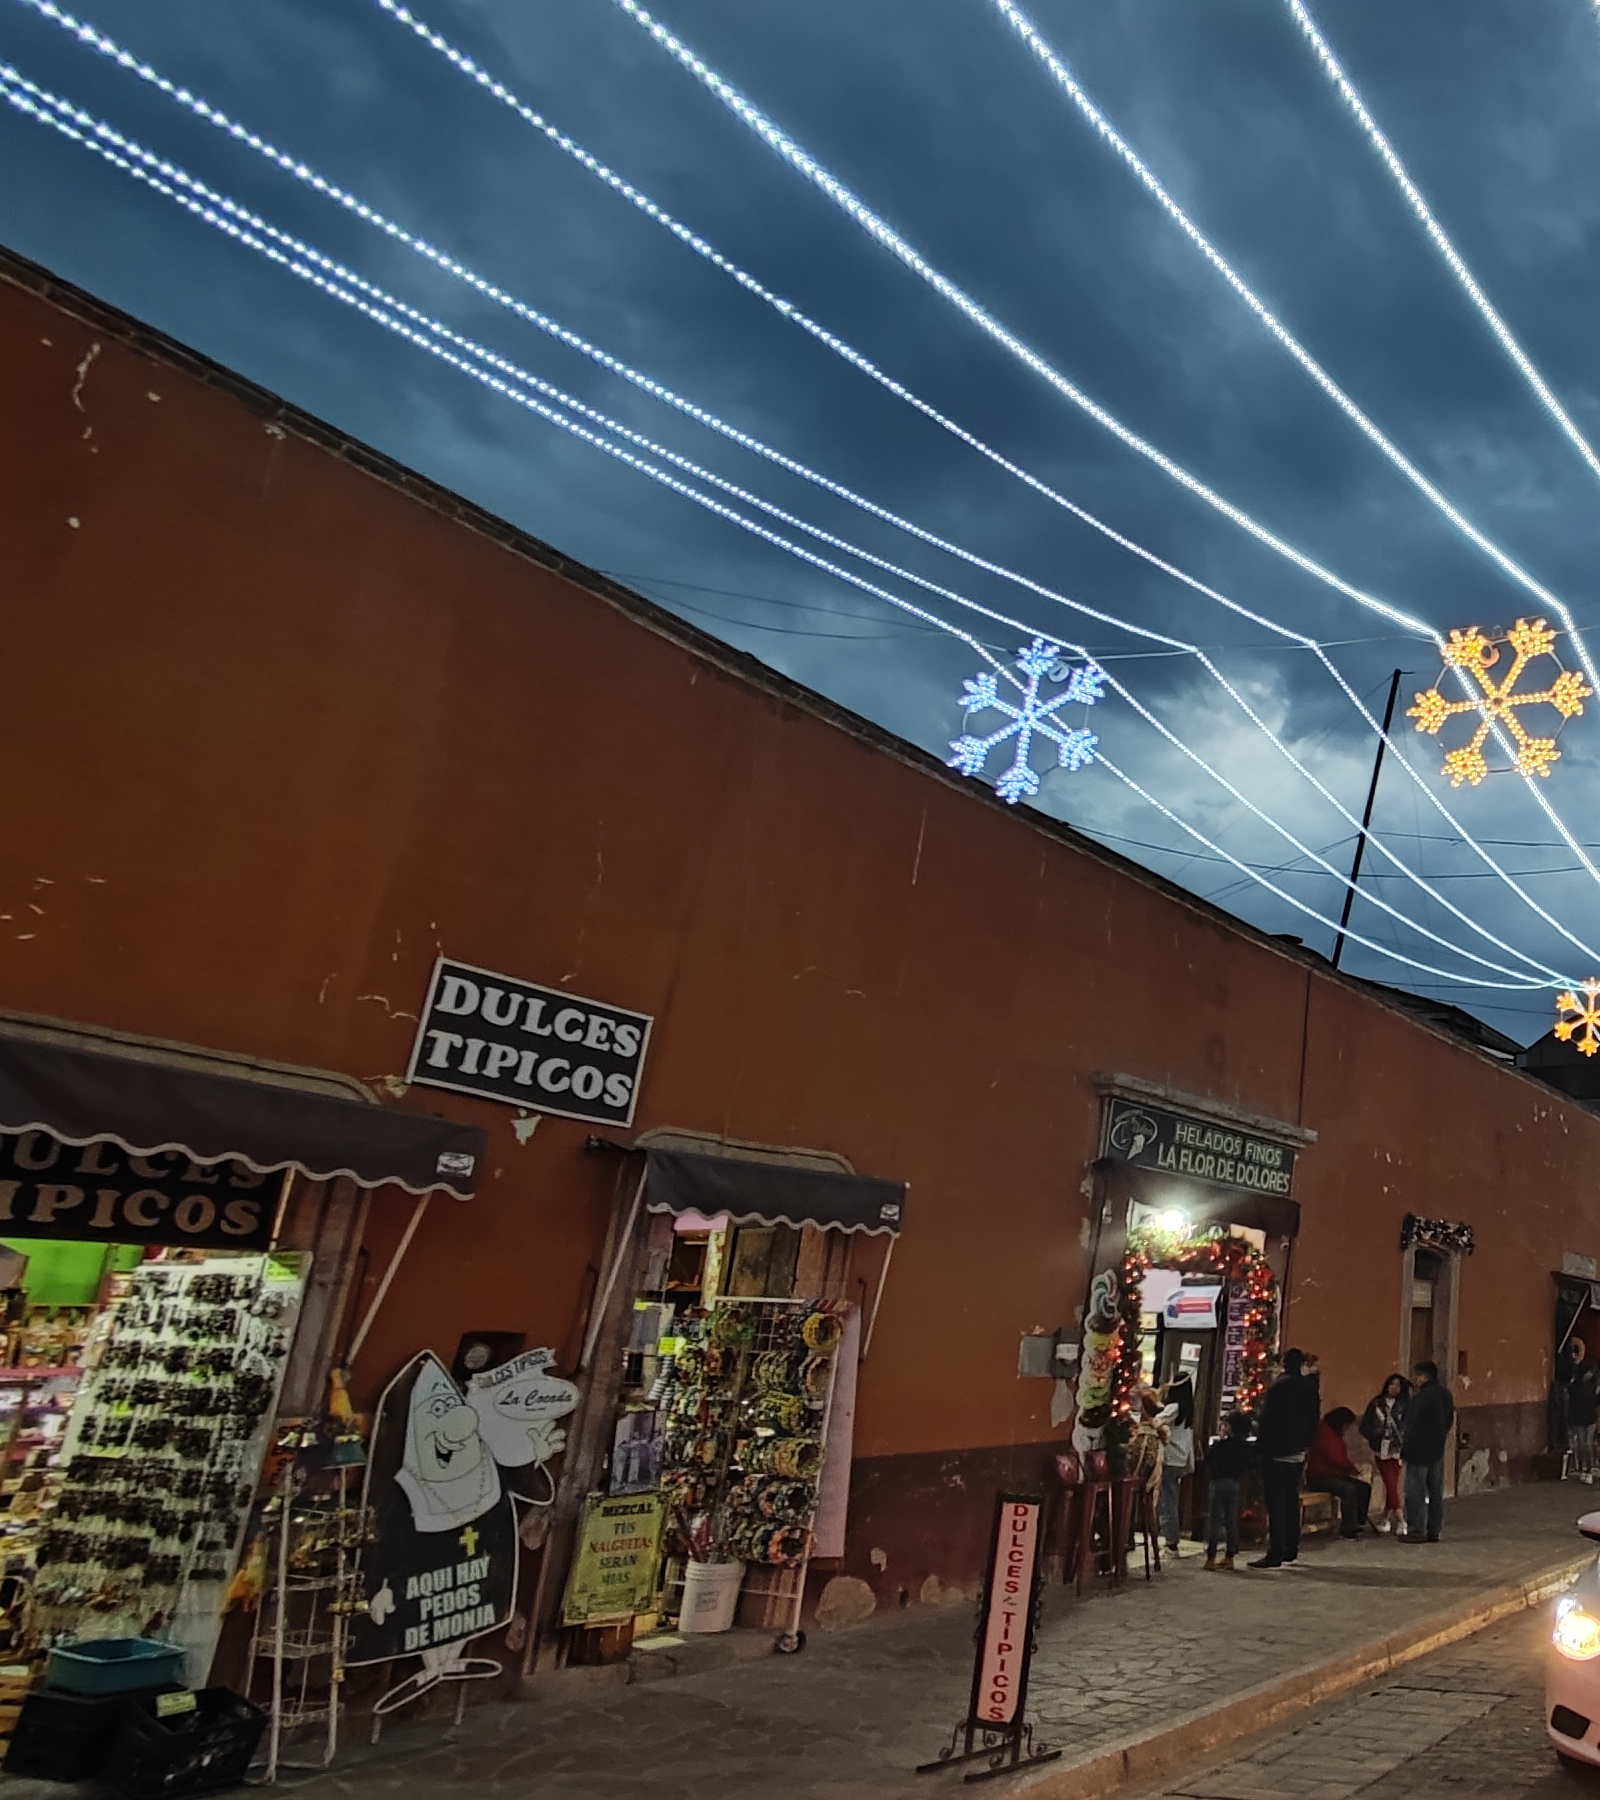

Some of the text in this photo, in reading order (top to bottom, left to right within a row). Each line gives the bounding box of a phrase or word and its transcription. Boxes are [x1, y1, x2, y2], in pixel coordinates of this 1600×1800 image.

[434, 975, 642, 1058] DULCES
[426, 1029, 634, 1108] TIPICOS
[0, 1131, 266, 1189] ULCES
[1157, 1142, 1291, 1193] LA FLOR DE DOLORES
[1175, 1121, 1242, 1157] HELADOS
[1244, 1138, 1283, 1167] FINOS
[499, 1390, 521, 1406] La
[601, 1502, 654, 1517] MEZCAL
[1004, 1504, 1028, 1593] DULCES
[406, 1555, 490, 1600] AQUI HAY
[420, 1583, 481, 1621] PEDOS
[404, 1602, 496, 1651] DE MONJA
[990, 1611, 1017, 1720] TIPICOS
